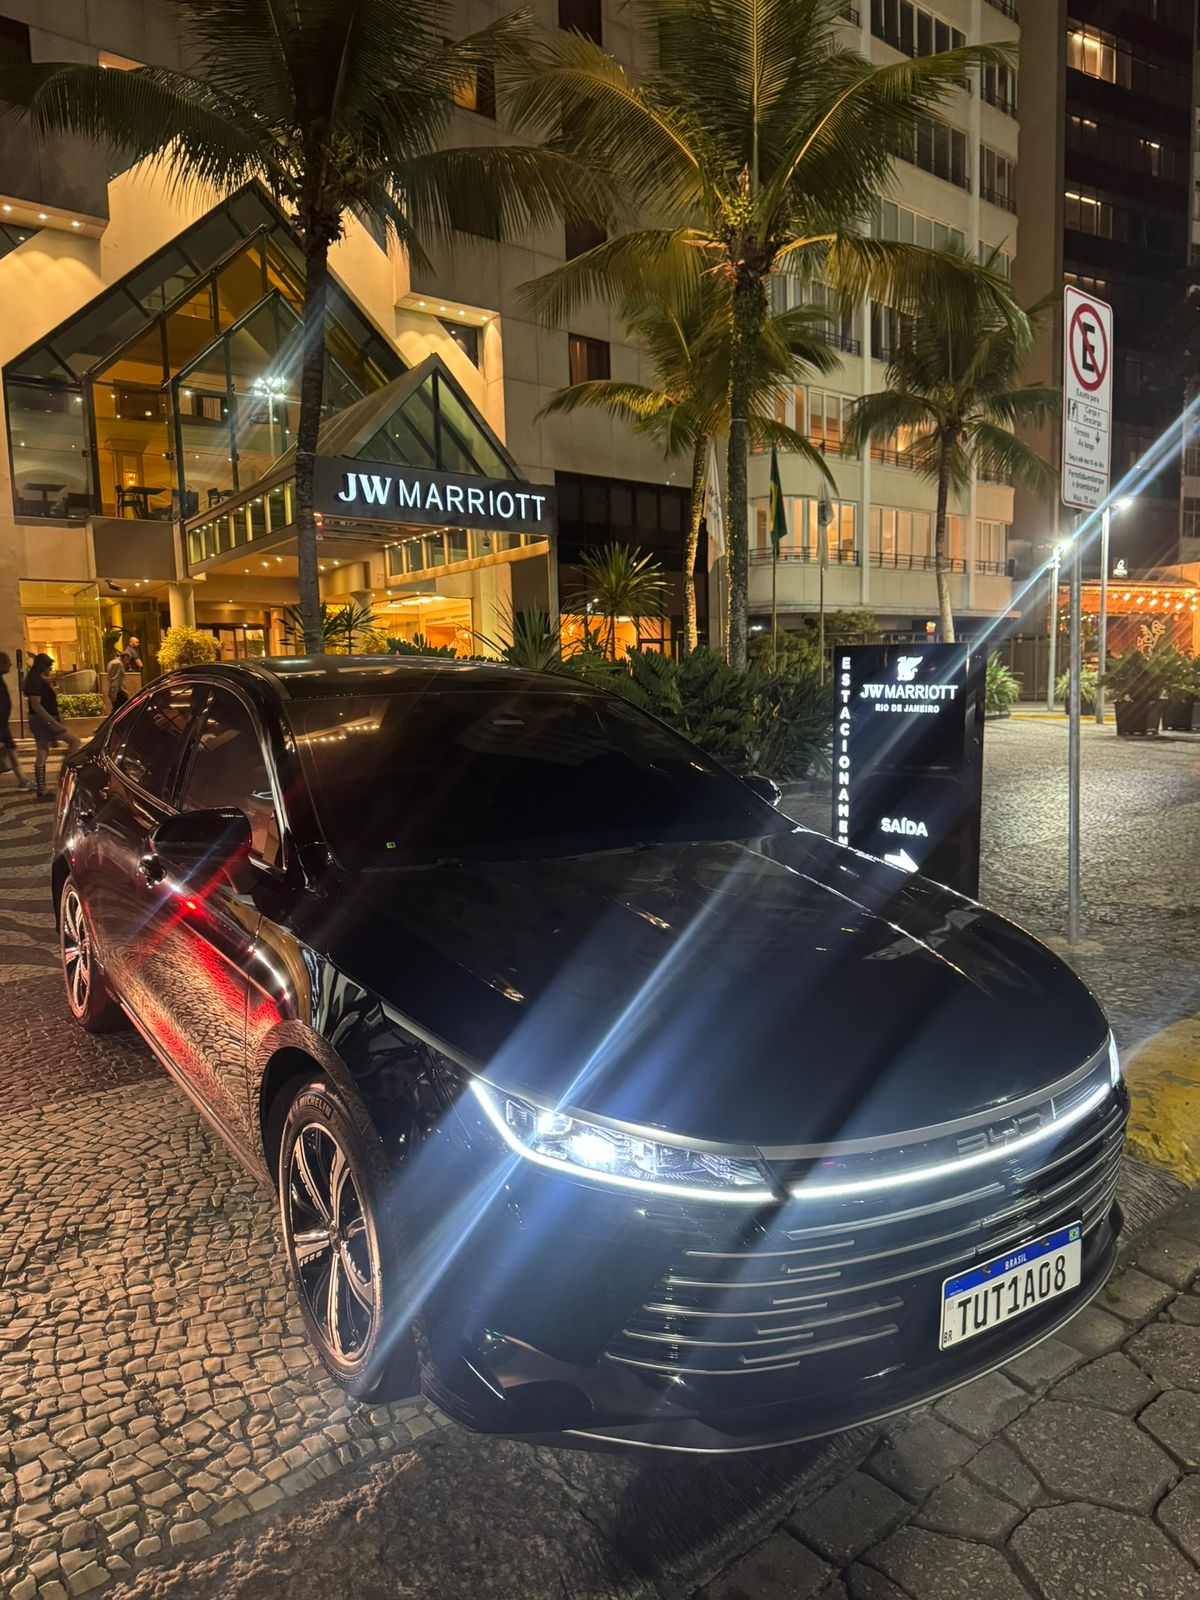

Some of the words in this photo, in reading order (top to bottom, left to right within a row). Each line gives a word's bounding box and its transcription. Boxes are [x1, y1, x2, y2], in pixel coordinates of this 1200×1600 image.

[338, 472, 392, 505] JW
[399, 479, 546, 521] MARRIOTT
[860, 684, 884, 698] JW
[884, 684, 958, 699] MARRIOTT
[875, 703, 889, 712] RIO
[891, 703, 902, 712] DE
[903, 704, 940, 713] JANEIRO
[881, 817, 928, 837] SAÍDA
[1005, 1253, 1027, 1270] BRASIL
[958, 1255, 1066, 1335] TUT1A08
[943, 1330, 953, 1344] BR
